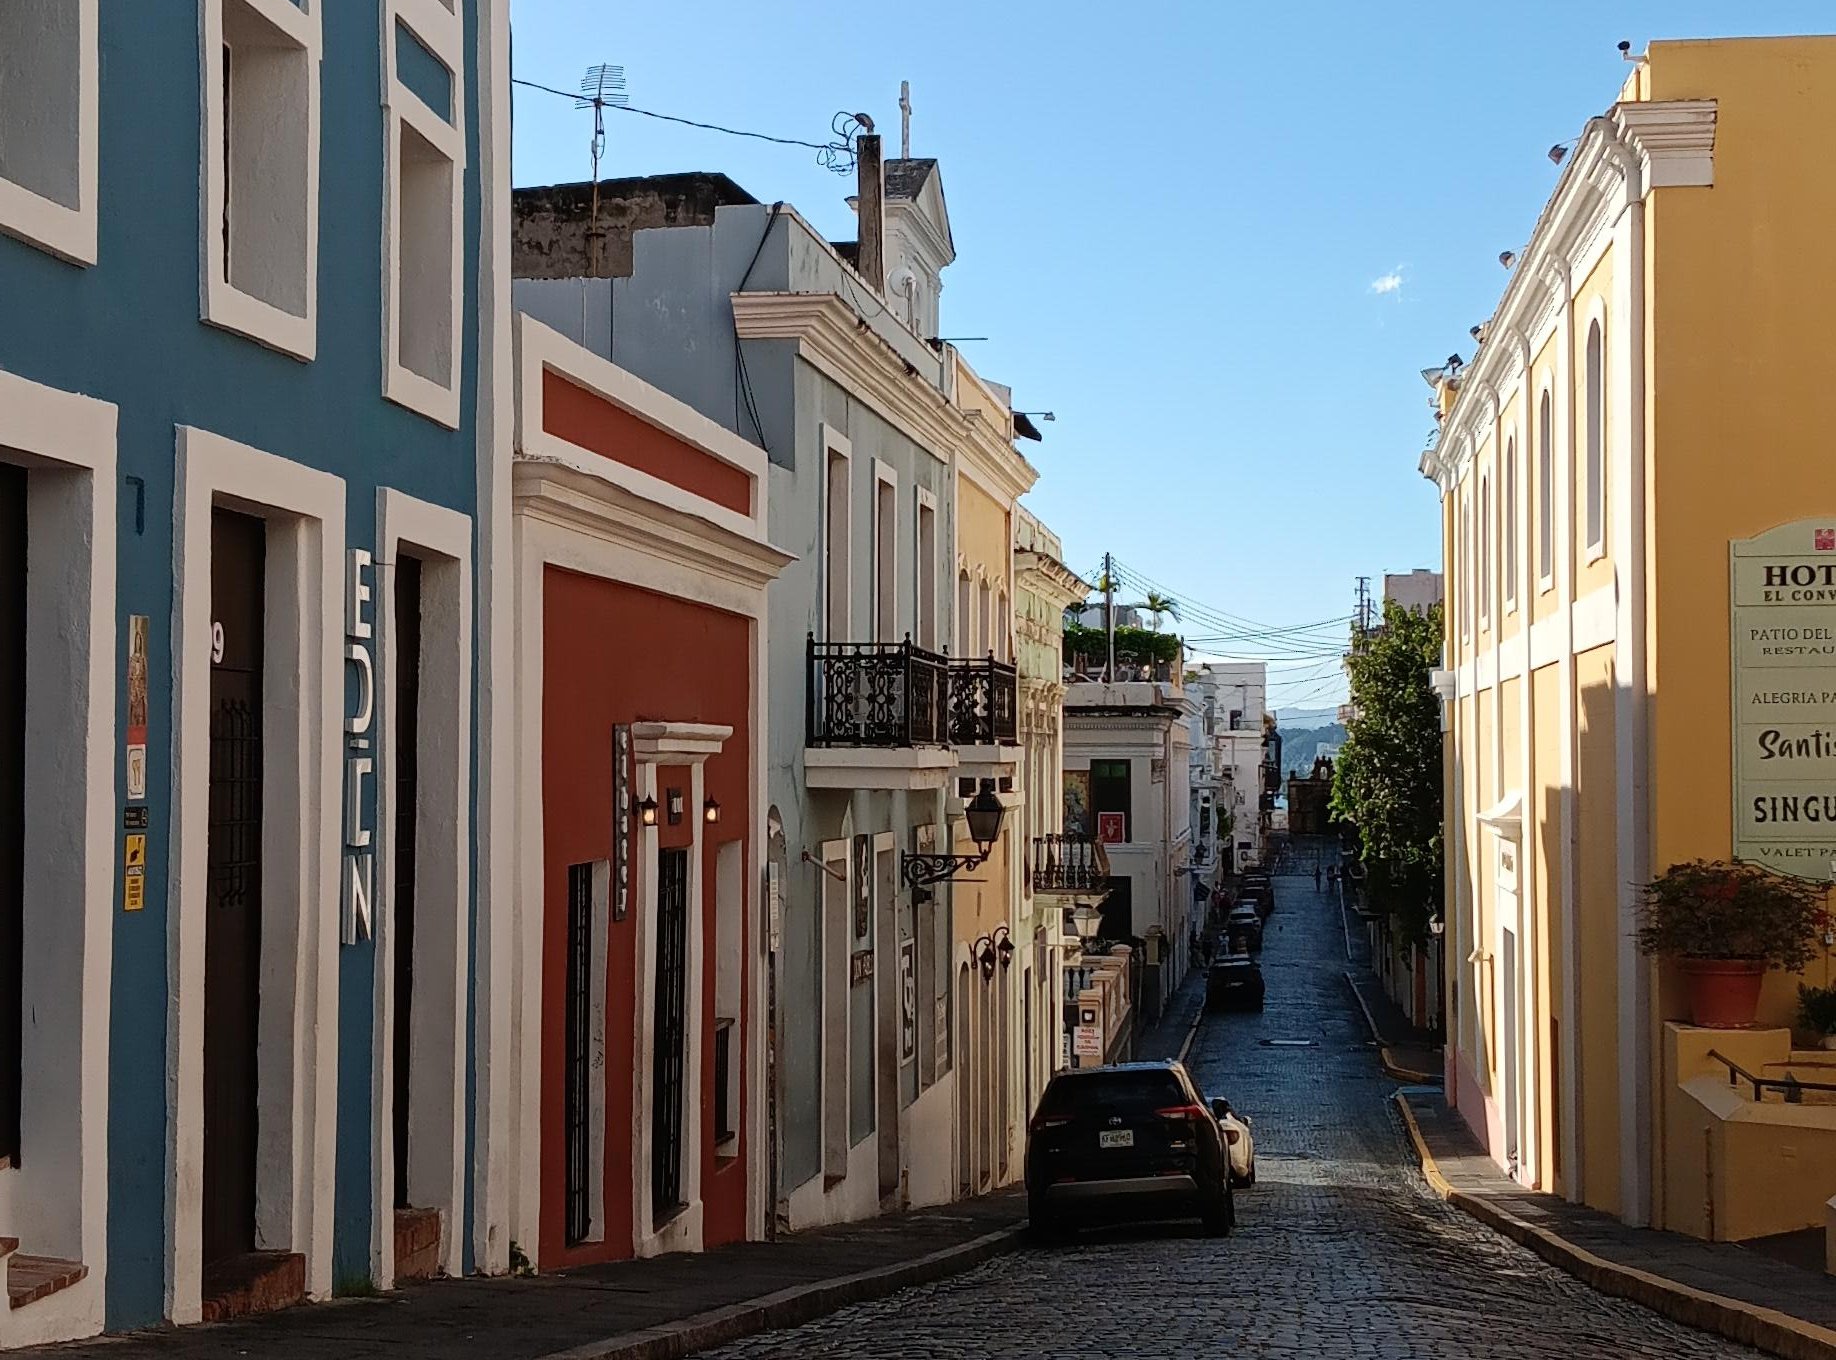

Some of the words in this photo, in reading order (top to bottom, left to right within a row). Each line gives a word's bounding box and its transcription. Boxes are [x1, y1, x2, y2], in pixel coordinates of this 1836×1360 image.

[1763, 565, 1836, 586] HOT
[1764, 591, 1783, 601] EL
[1750, 629, 1798, 640] PATIO
[1803, 628, 1832, 639] DEL
[1763, 646, 1834, 654] RESTAU
[1752, 692, 1817, 704] ALEGRIA
[1754, 796, 1836, 822] SINGU
[1760, 848, 1814, 857] VALET
